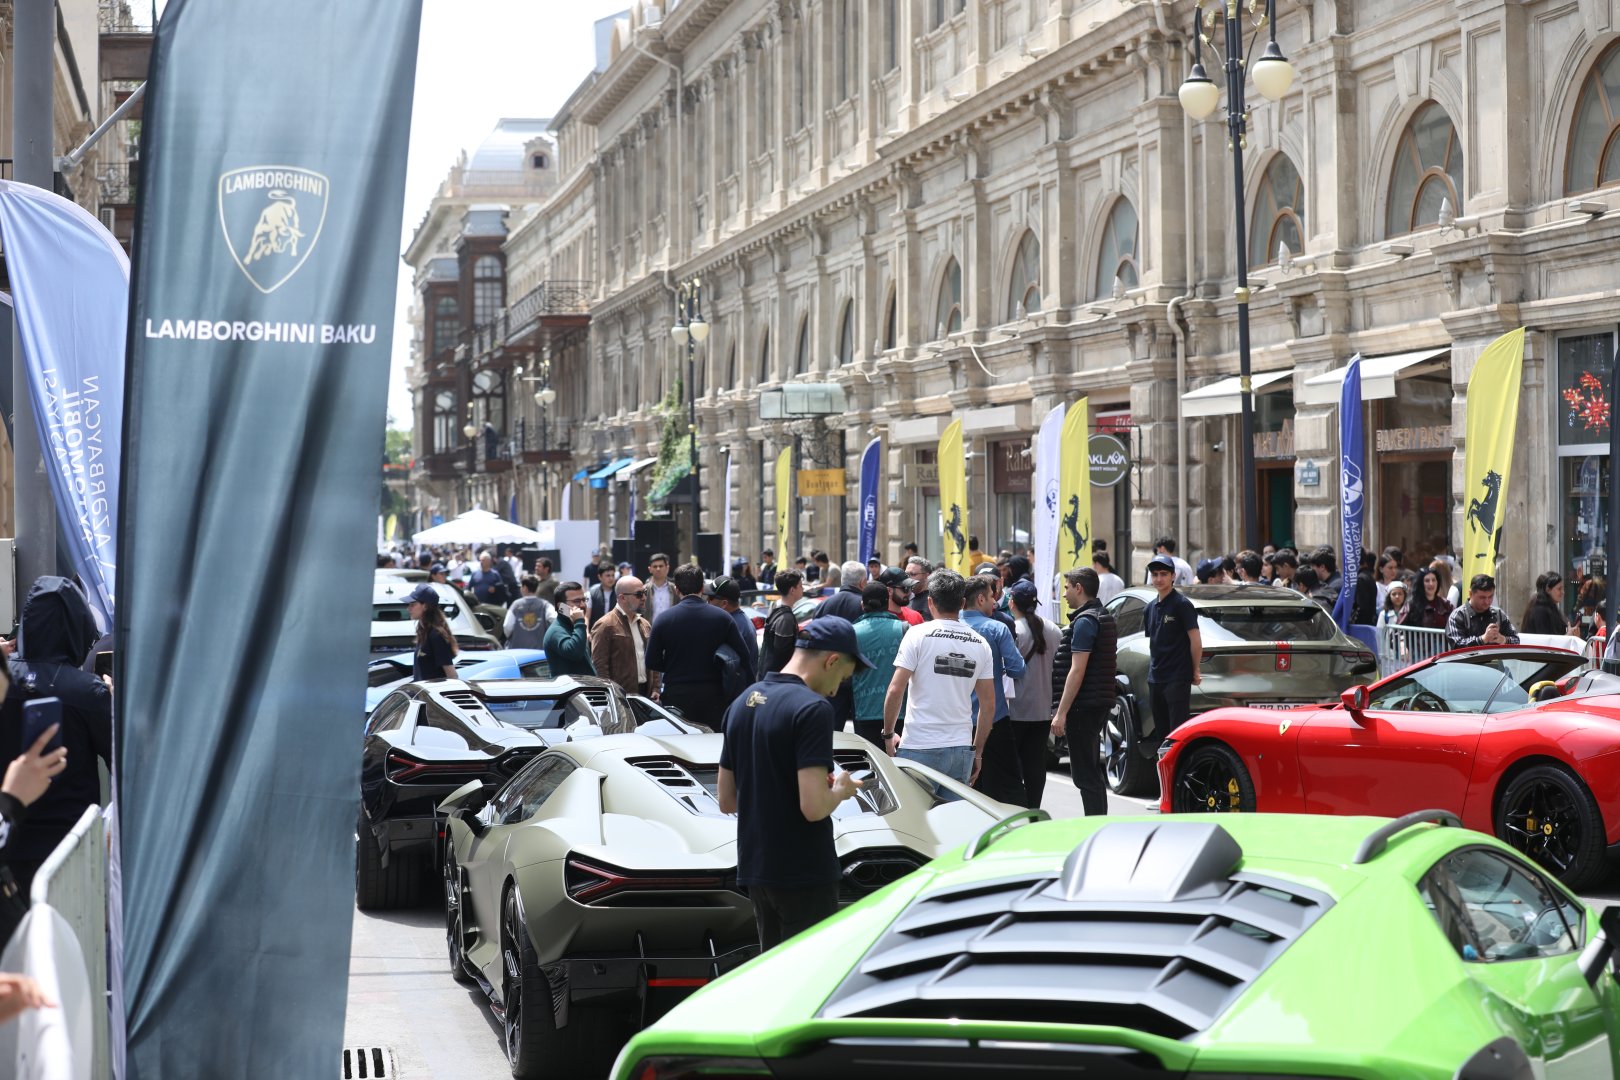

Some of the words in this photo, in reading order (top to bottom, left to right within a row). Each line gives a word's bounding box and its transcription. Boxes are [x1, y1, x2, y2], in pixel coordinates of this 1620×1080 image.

[225, 171, 323, 197] LAMBORGHINI
[145, 318, 315, 343] LAMBORGHINI
[320, 324, 376, 344] BAKU
